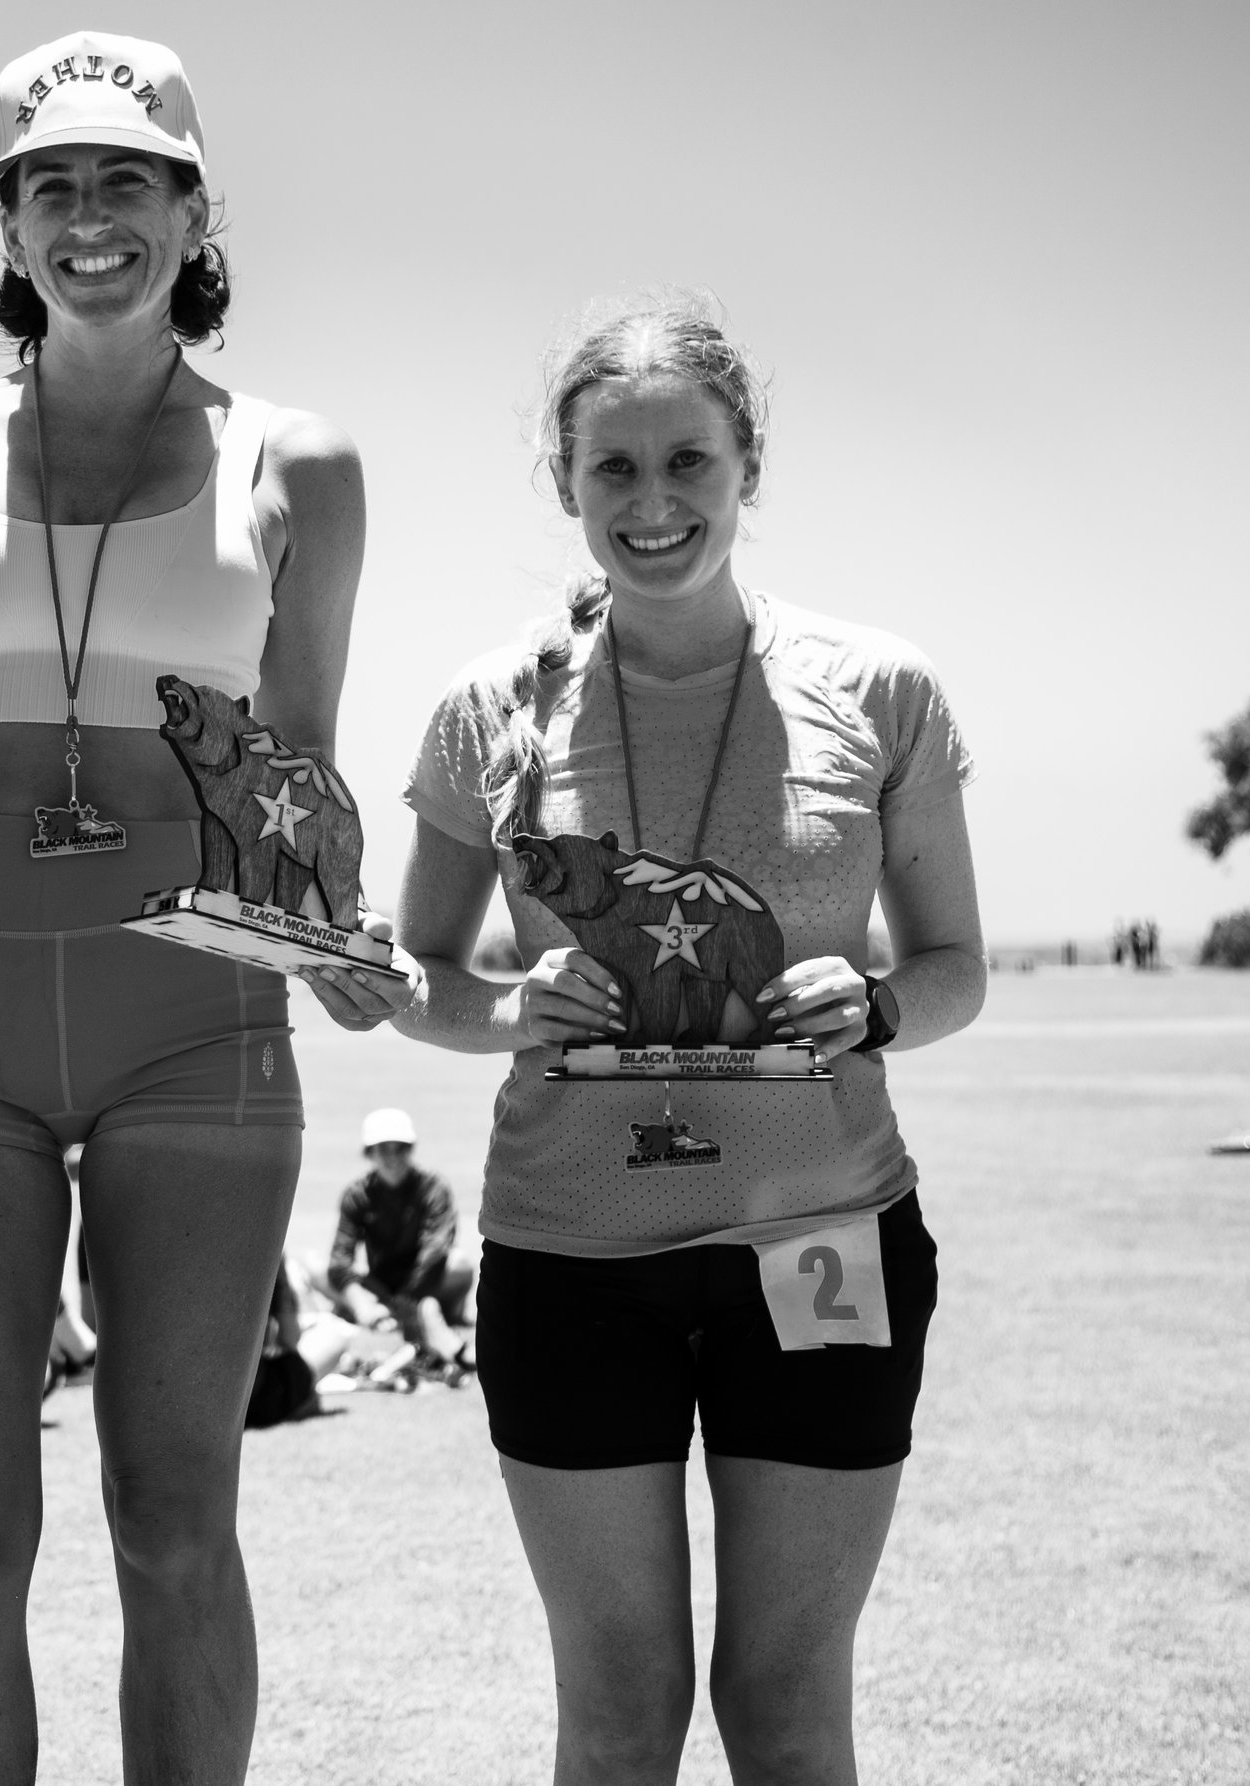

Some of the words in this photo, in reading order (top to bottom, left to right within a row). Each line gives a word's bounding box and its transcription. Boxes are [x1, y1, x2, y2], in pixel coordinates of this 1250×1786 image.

[15, 55, 163, 125] MOTHER
[273, 803, 296, 828] 1st
[32, 836, 67, 849] BLACK
[68, 831, 124, 846] MOUNTAIN
[73, 844, 97, 852] TRAIL
[98, 840, 125, 849] RACES
[240, 904, 283, 928] BLACK
[283, 917, 350, 947] MOUNTAIN
[287, 931, 313, 945] TRAIL
[316, 940, 347, 955] RACES
[666, 924, 698, 950] 3rd
[619, 1051, 671, 1064] BLACK
[673, 1051, 756, 1065] MOUNTAIN
[678, 1064, 714, 1073] TRAIL
[716, 1064, 756, 1073] RACES
[626, 1152, 662, 1165] BLACK
[663, 1147, 721, 1161] MOUNTAIN
[694, 1156, 722, 1165] RACES
[797, 1245, 860, 1321] 2
